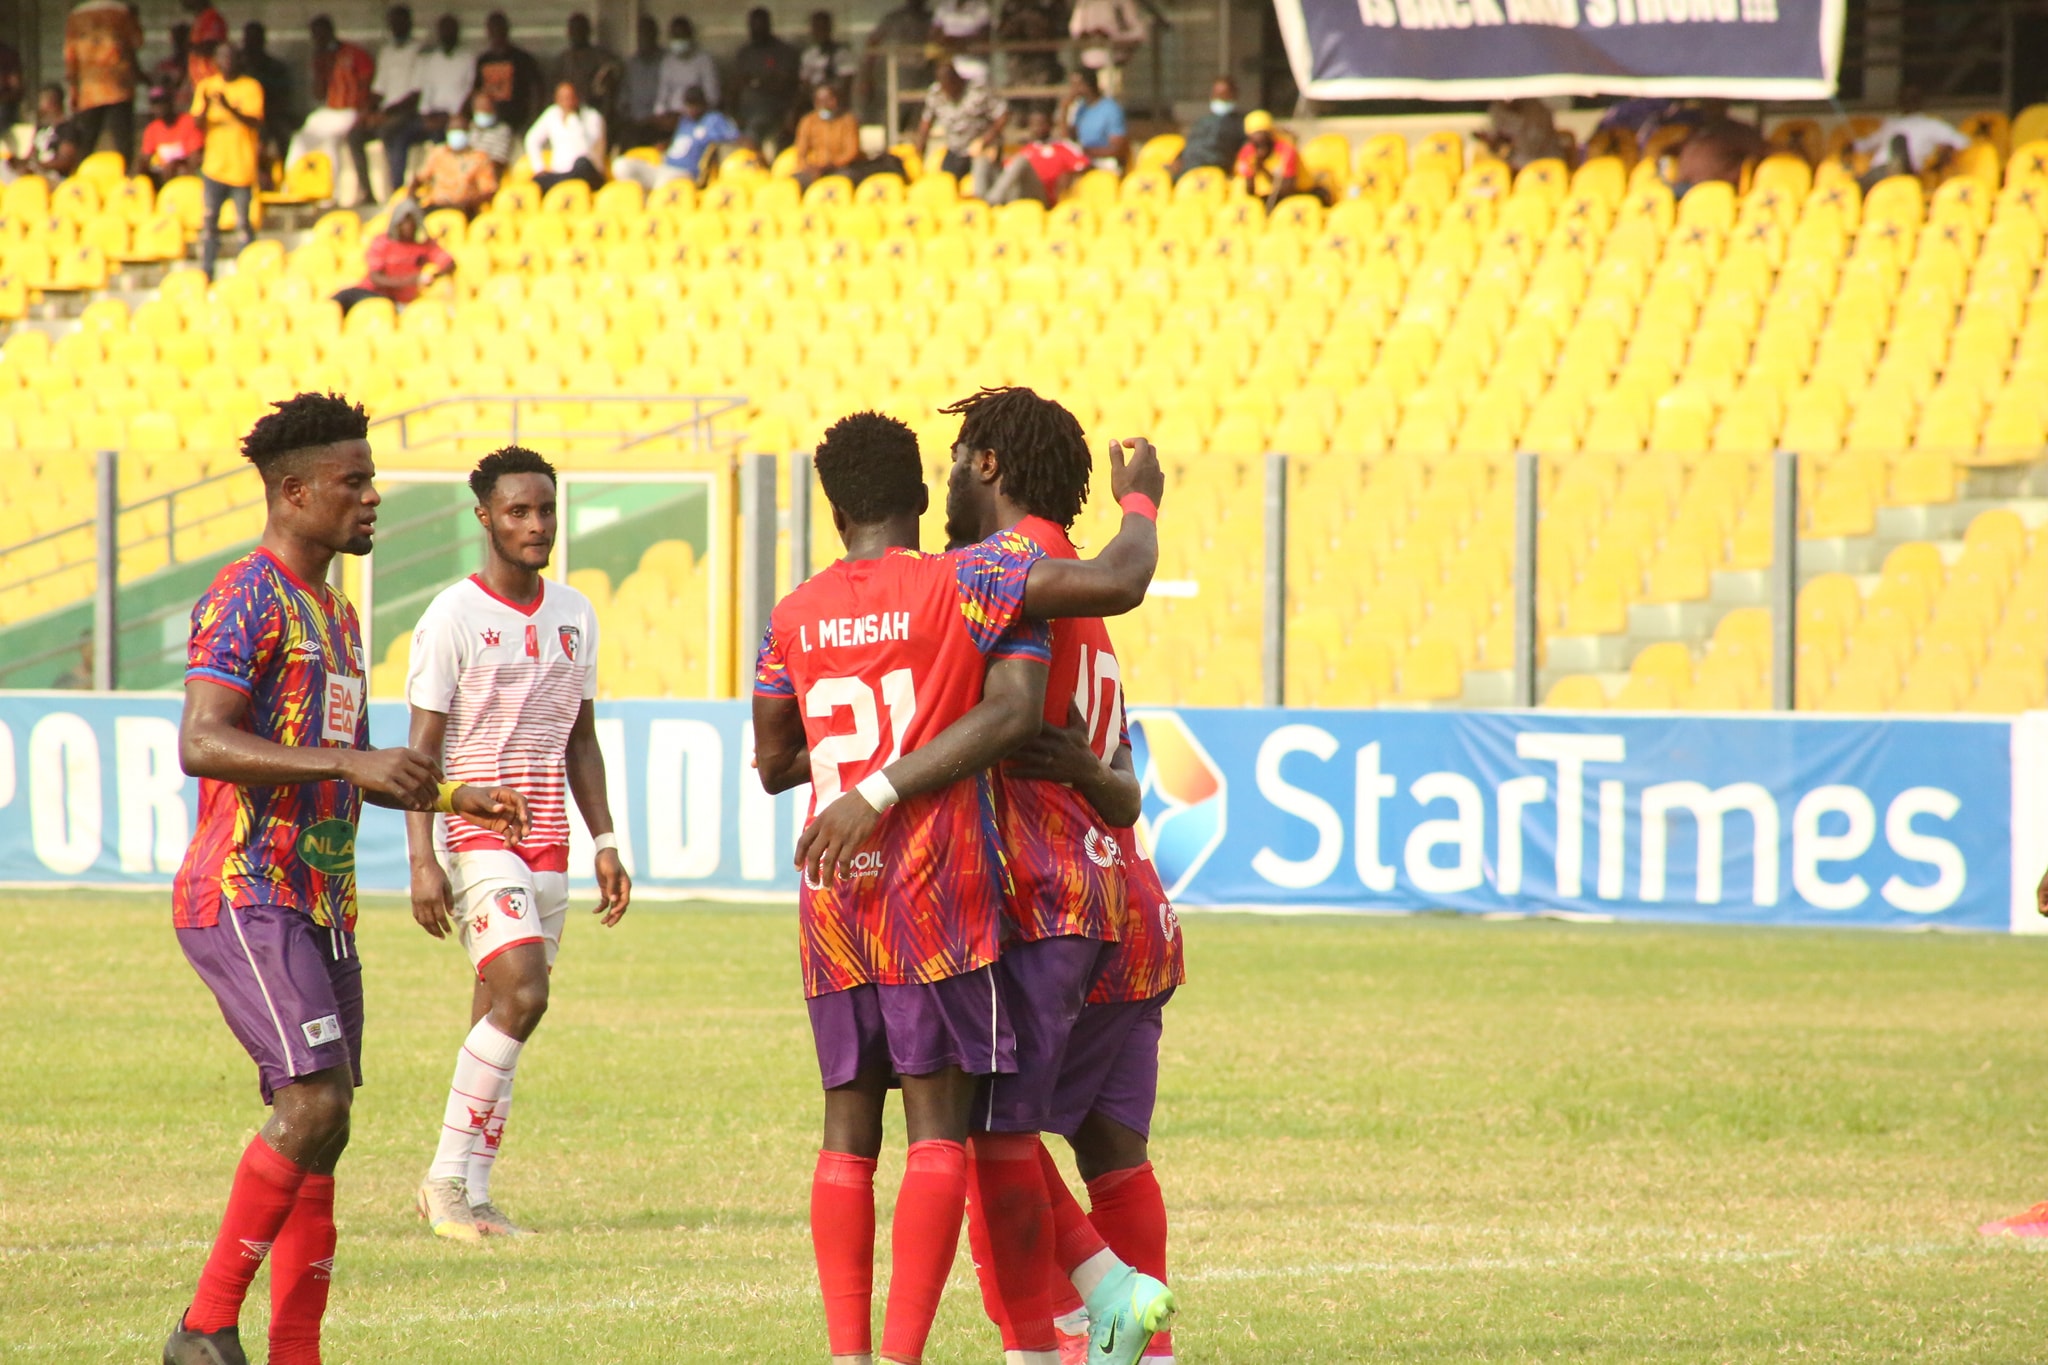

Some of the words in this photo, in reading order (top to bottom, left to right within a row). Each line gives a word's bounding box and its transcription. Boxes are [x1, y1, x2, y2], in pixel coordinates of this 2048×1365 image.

[525, 624, 540, 664] 4
[819, 611, 910, 649] MENSAH
[805, 667, 917, 817] 21
[0, 712, 190, 875] OR
[1251, 723, 1967, 914] StarTimes
[303, 834, 355, 856] NLA
[837, 851, 884, 870] OIL
